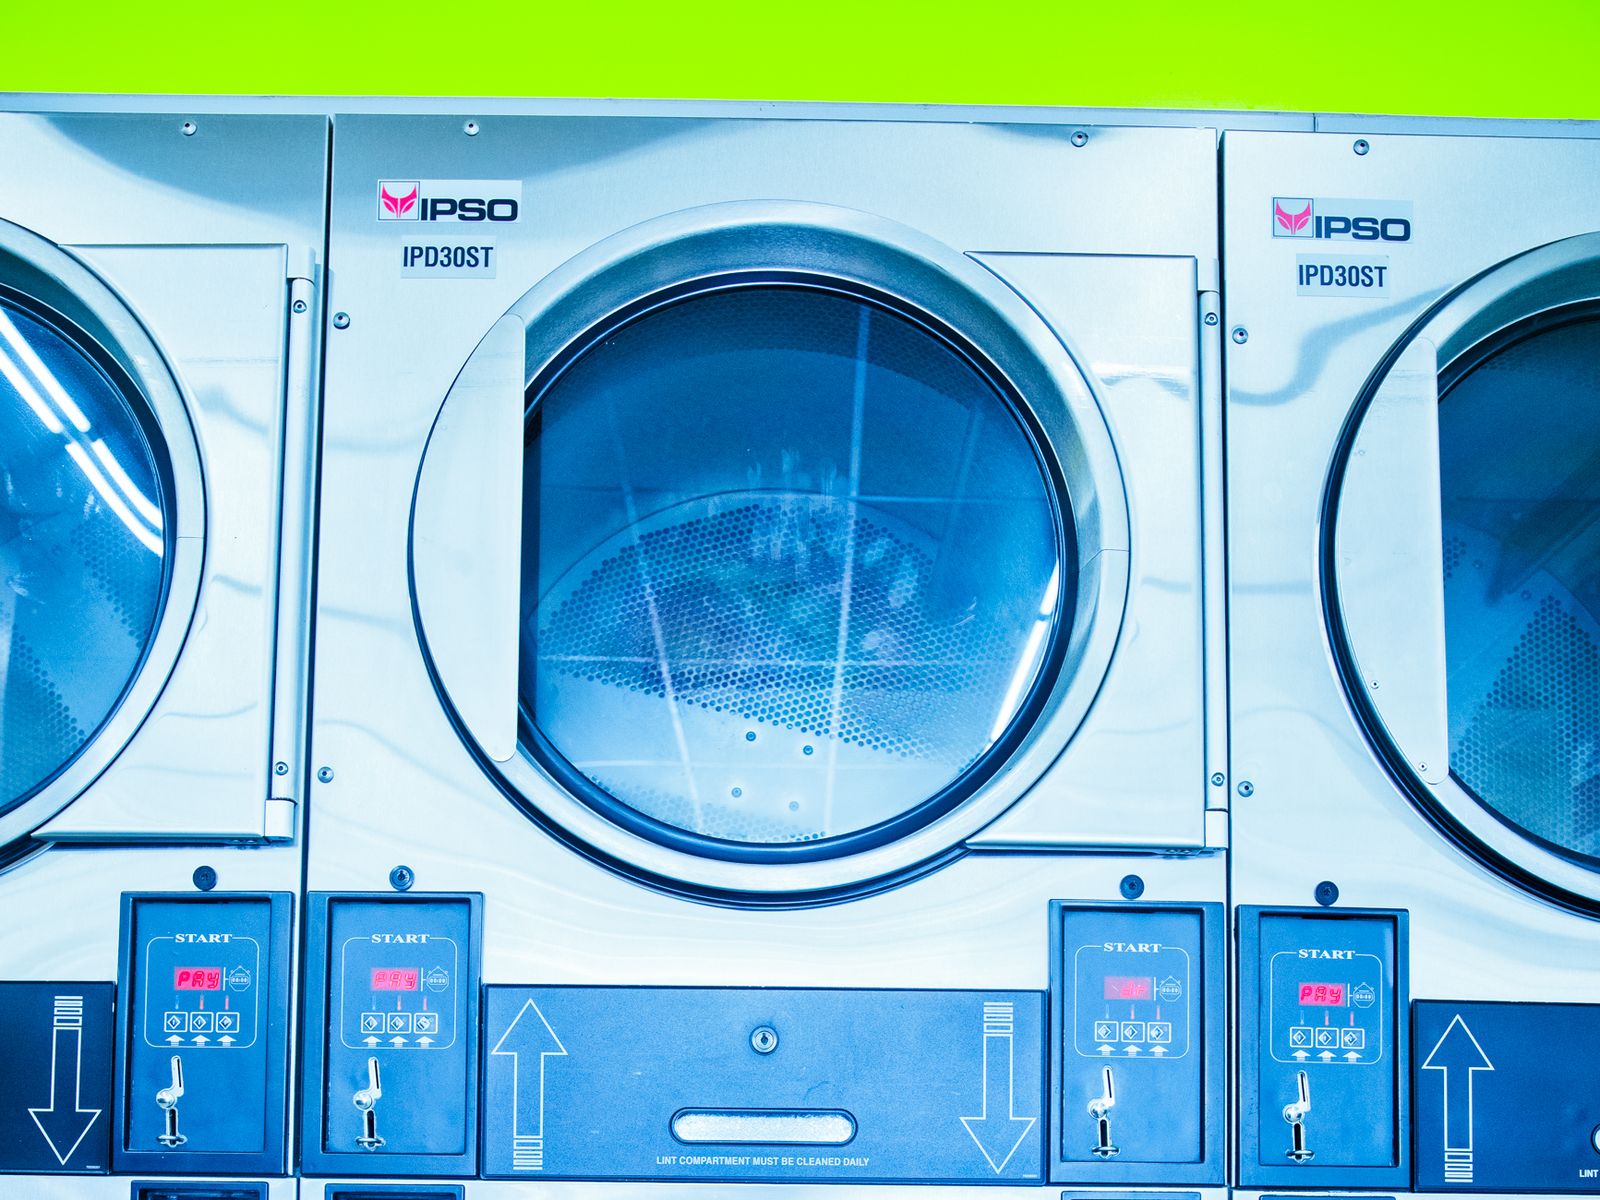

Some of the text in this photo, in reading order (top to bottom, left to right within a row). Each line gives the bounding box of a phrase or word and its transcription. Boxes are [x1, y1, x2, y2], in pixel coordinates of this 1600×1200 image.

[420, 198, 518, 222] IPSO
[1315, 215, 1411, 242] IPSO
[403, 246, 494, 268] IPD30ST
[1298, 264, 1388, 287] IPD30ST
[175, 933, 232, 943] START
[371, 933, 430, 944] START
[1103, 942, 1162, 953] START
[1298, 949, 1355, 960] START
[656, 1156, 869, 1167] LINT COMPARTMENT MUST BE CLEANED DAILY
[1579, 1169, 1599, 1178] LINT
